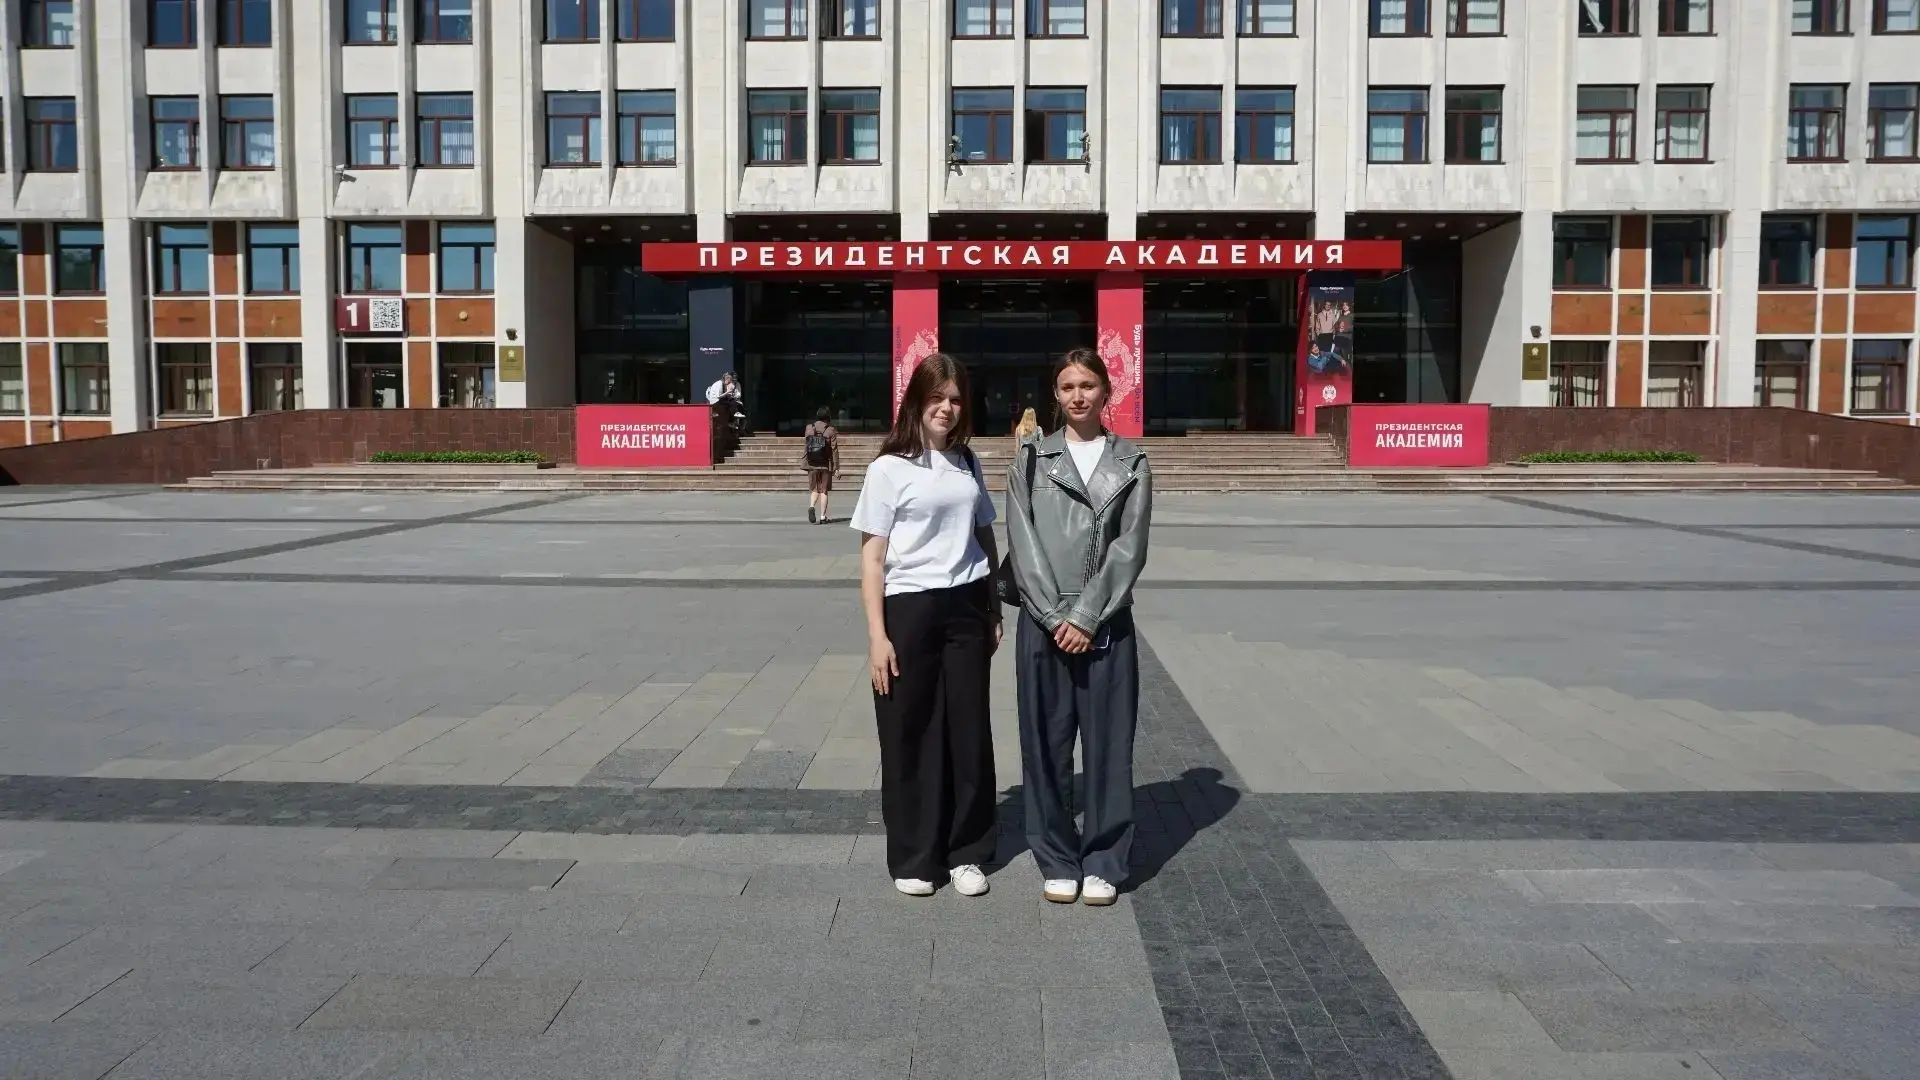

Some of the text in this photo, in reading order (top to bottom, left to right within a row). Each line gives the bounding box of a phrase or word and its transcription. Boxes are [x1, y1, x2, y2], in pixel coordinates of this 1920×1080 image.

[700, 244, 1344, 267] ПРЕЗИДЕНТСКАЯ АКАДЕМИЯ
[346, 302, 358, 327] 1
[1133, 324, 1142, 346] Будь
[600, 423, 686, 432] ПРЕЗИДЕНТСКАЯ
[1375, 423, 1463, 431] ПРЕЗИДЕНТСКАЯ
[601, 434, 686, 449] АКАДЕМИЯ
[1375, 433, 1463, 448] АКАДЕМИЯ
